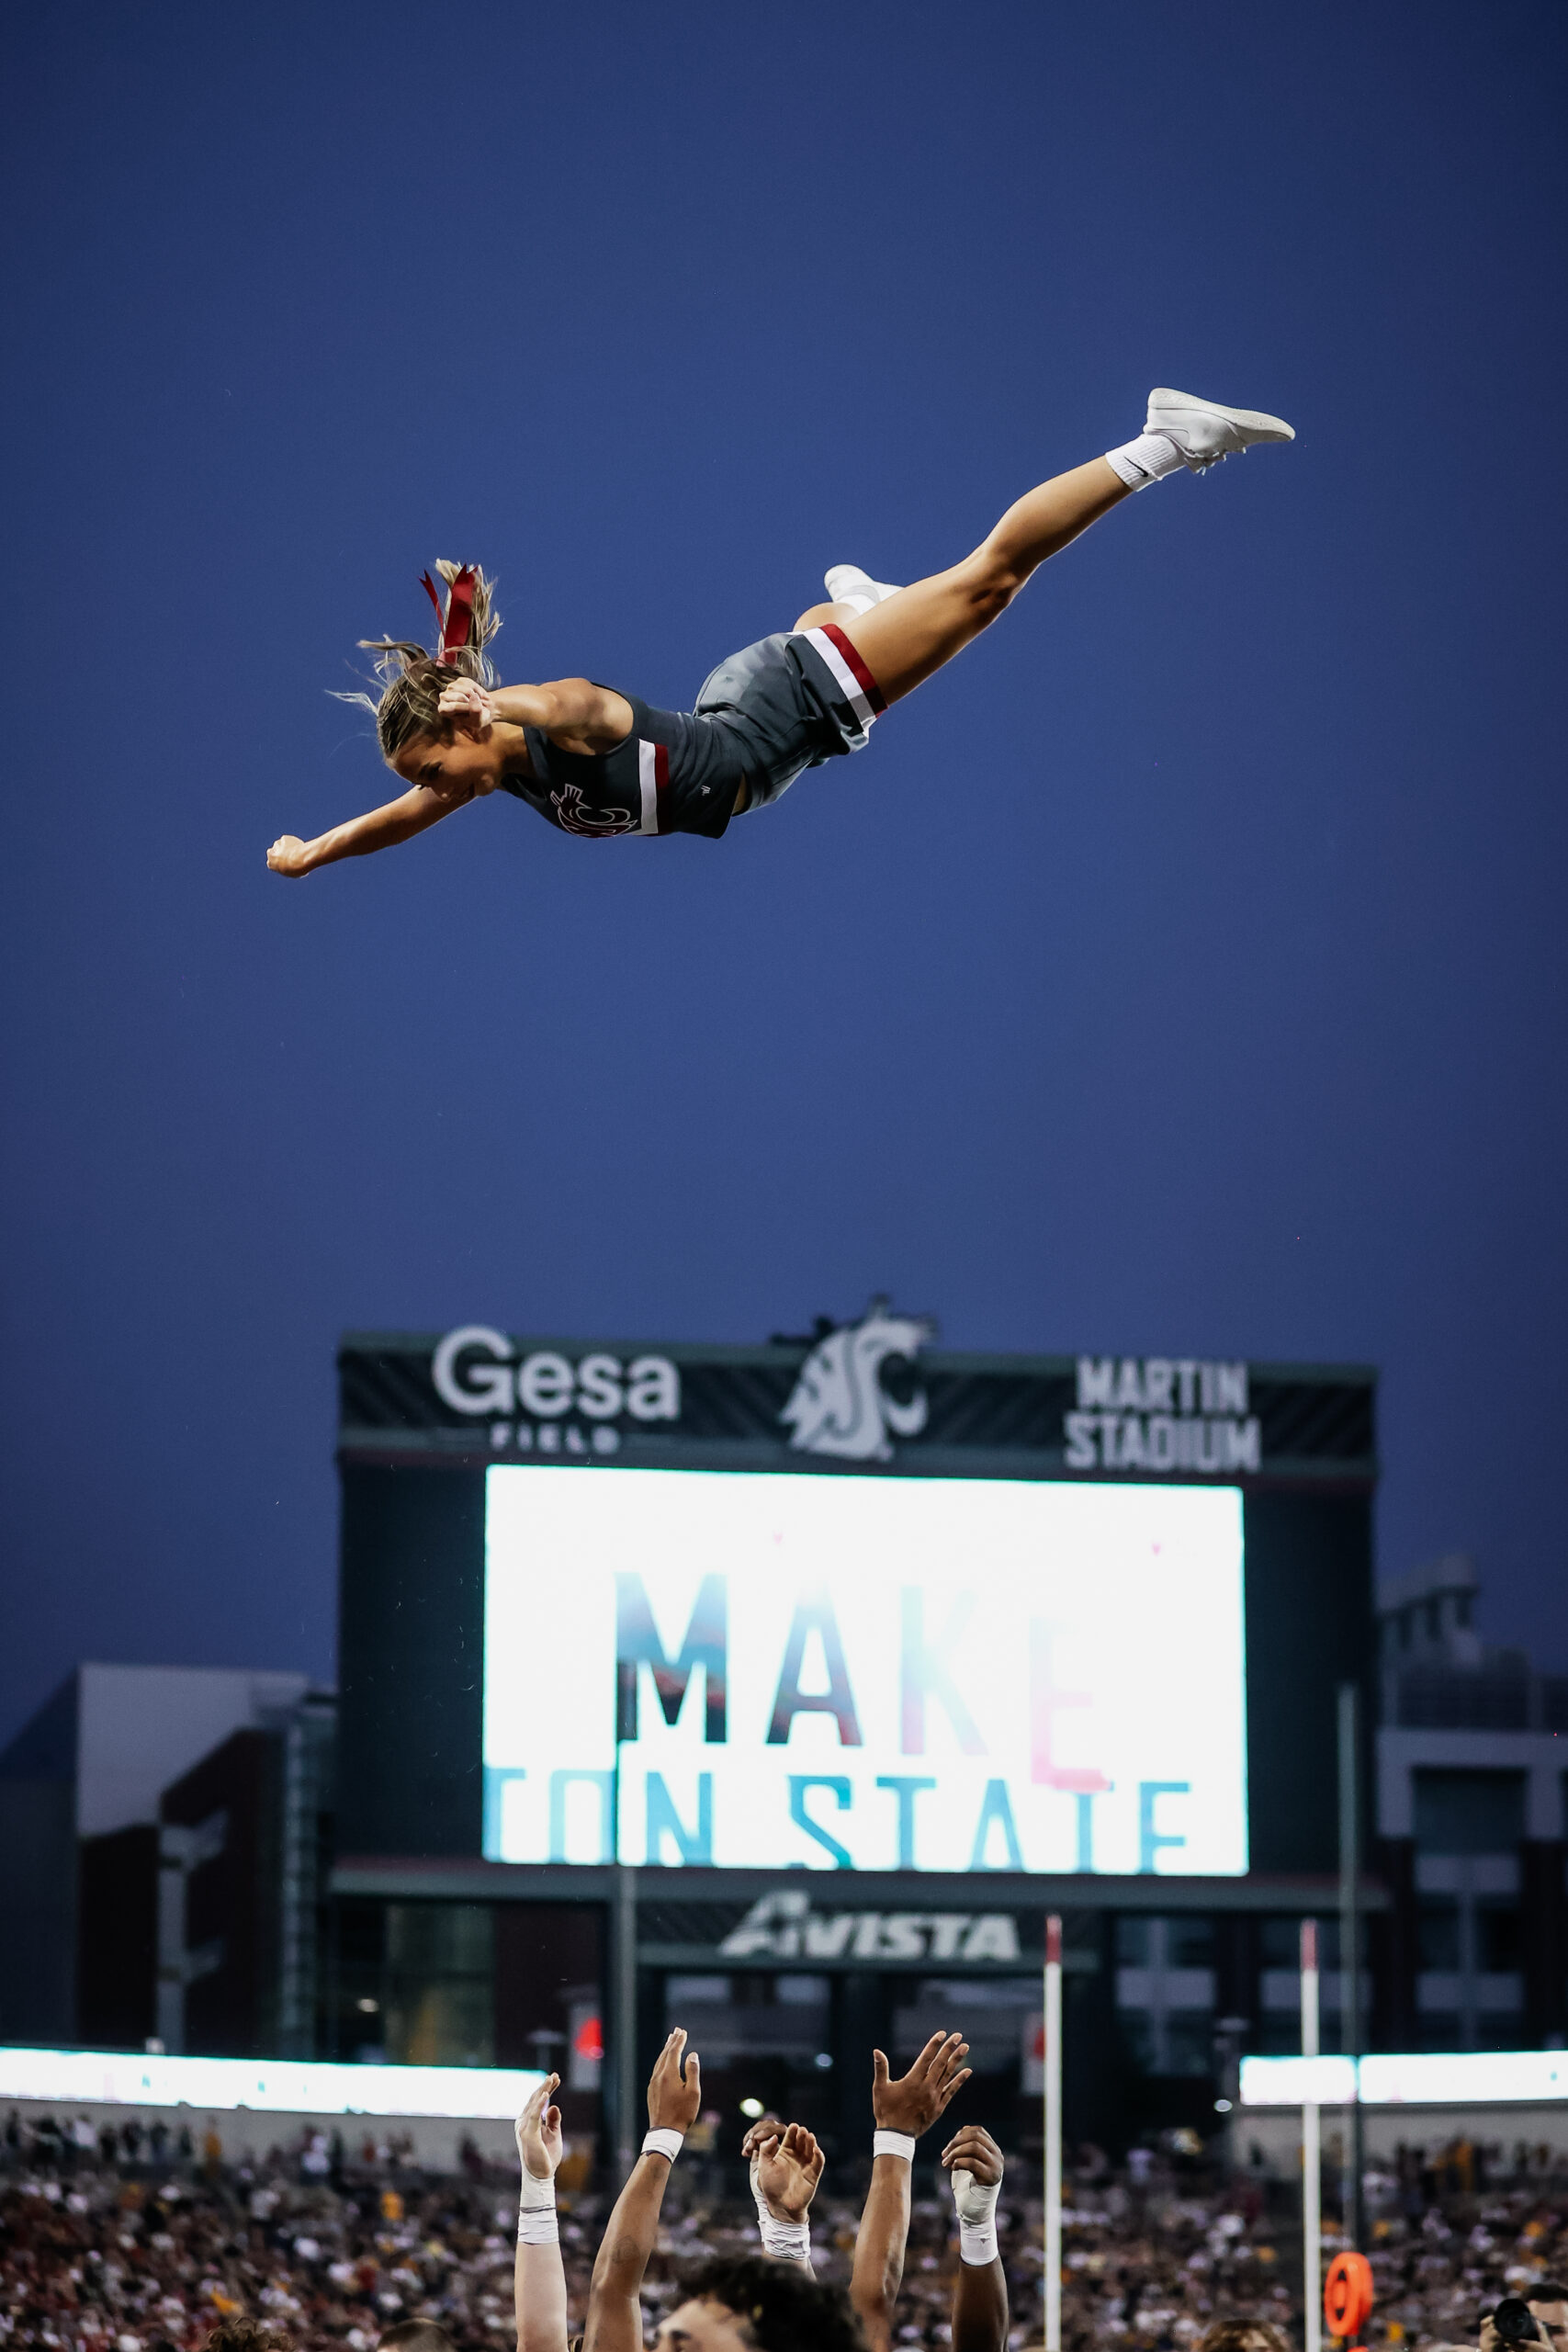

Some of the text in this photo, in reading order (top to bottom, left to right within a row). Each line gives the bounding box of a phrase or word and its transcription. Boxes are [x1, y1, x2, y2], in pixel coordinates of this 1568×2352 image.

[433, 1326, 681, 1421] Gesa
[1077, 1358, 1247, 1413] MARTIN
[491, 1423, 620, 1453] FIELD
[1065, 1413, 1261, 1471] STADIUM
[615, 1571, 1108, 1788] MAKE
[718, 1890, 1021, 1962] AVISTA
